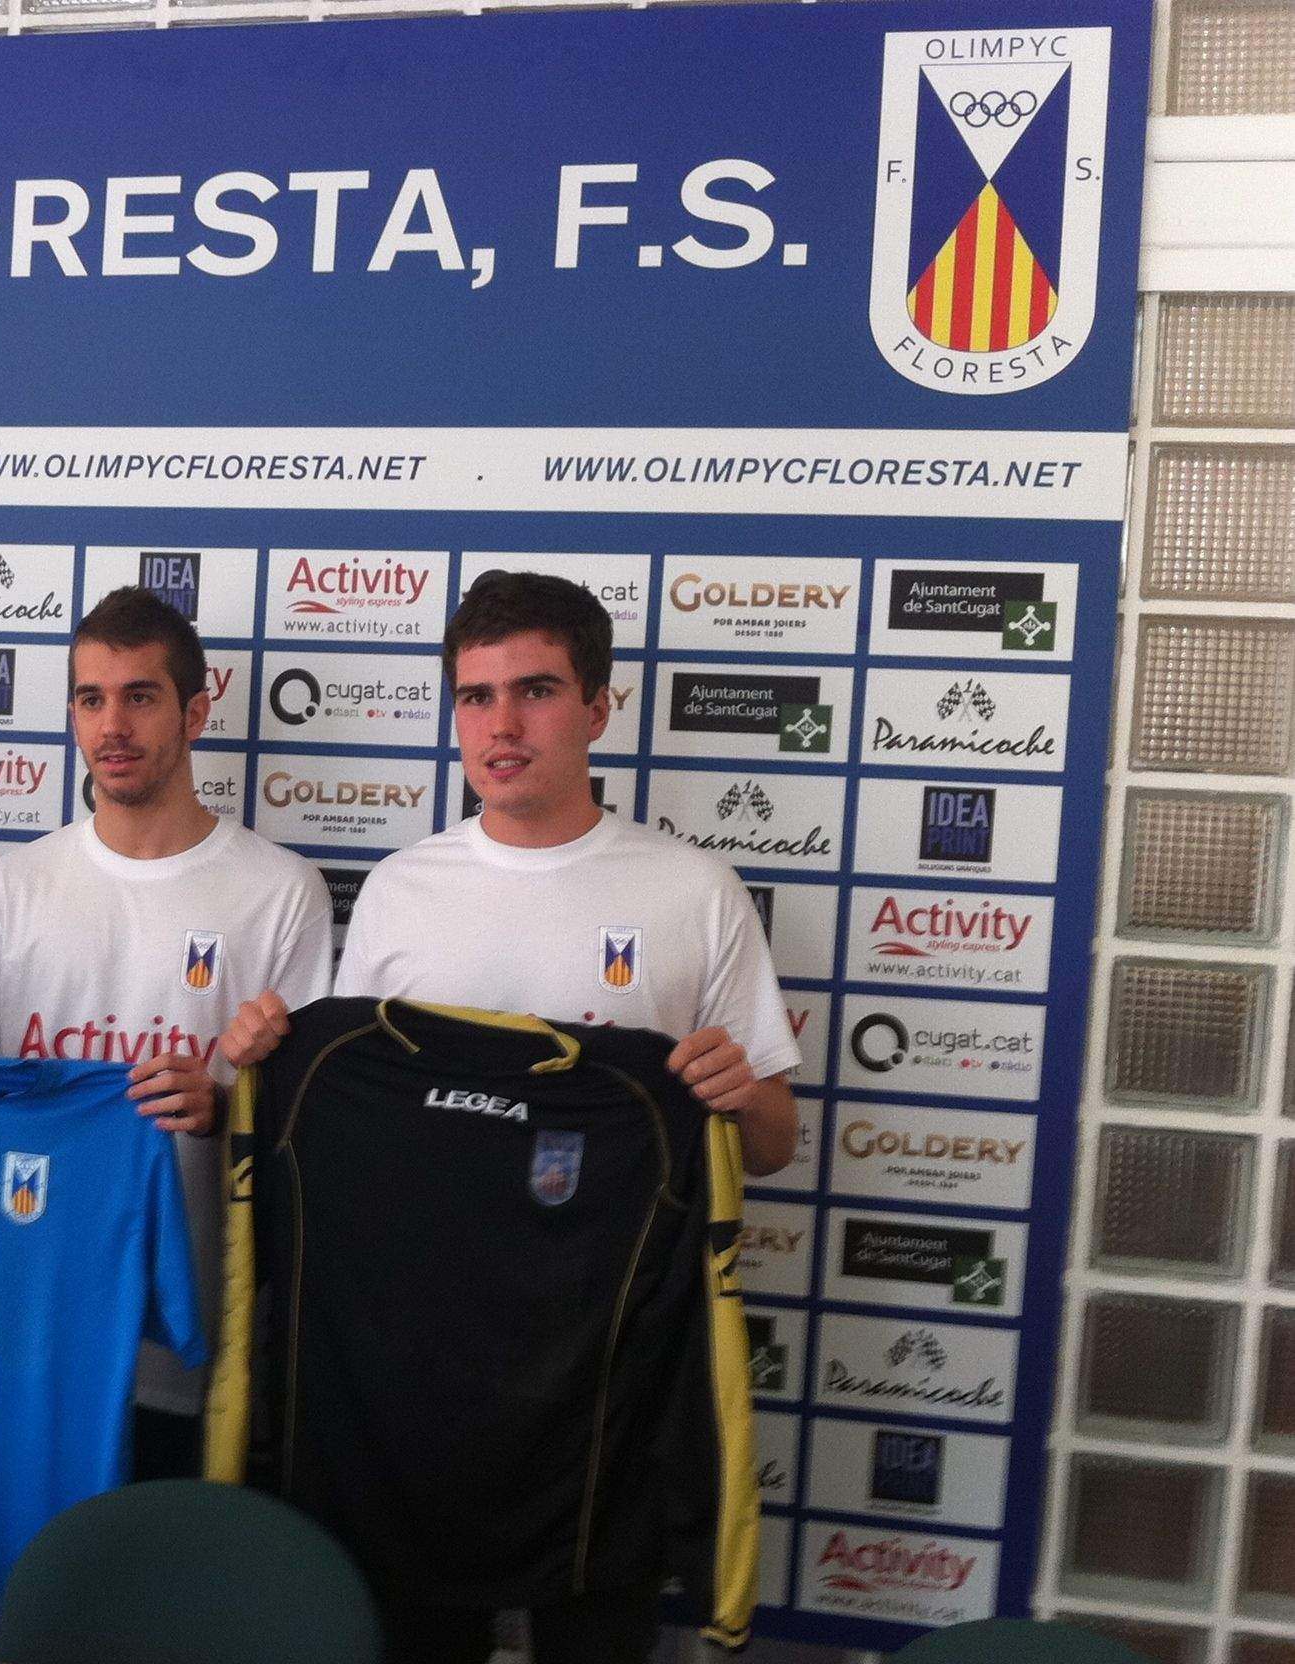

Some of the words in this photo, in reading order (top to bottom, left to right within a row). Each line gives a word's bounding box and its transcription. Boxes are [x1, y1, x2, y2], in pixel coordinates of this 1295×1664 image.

[925, 35, 1069, 59] OLIMPYC
[885, 159, 907, 184] F.
[1075, 156, 1101, 181] S.
[554, 158, 808, 269] F.S.
[893, 334, 1073, 385] FLORESTA
[543, 455, 1083, 489] WWW.OLIMPYCFLORESTA.NET
[144, 558, 195, 589] IDEA
[287, 557, 429, 604] Activity
[669, 572, 852, 612] GOLDERY
[909, 581, 996, 599] Ajuntament
[903, 599, 923, 613] de
[925, 600, 1002, 618] SantCugat
[284, 619, 421, 637] www.activity.cat
[713, 618, 733, 626] POR
[326, 680, 432, 704] cugat.cat
[689, 685, 774, 702] Ajuntament
[684, 702, 703, 715] de
[705, 702, 779, 720] SantCugat
[872, 716, 1055, 757] Paramicoche
[263, 771, 428, 808] GOLDERY
[303, 814, 320, 822] POR
[929, 792, 989, 828] IDEA
[871, 895, 1033, 950] Activity
[867, 960, 1023, 983] www.activity.cat
[914, 1028, 1034, 1053] cugat.cat
[423, 1087, 529, 1123] LEGEA
[842, 1119, 1027, 1165] GOLDERY
[861, 1231, 949, 1251] Ajuntament
[818, 1530, 978, 1591] Activity
